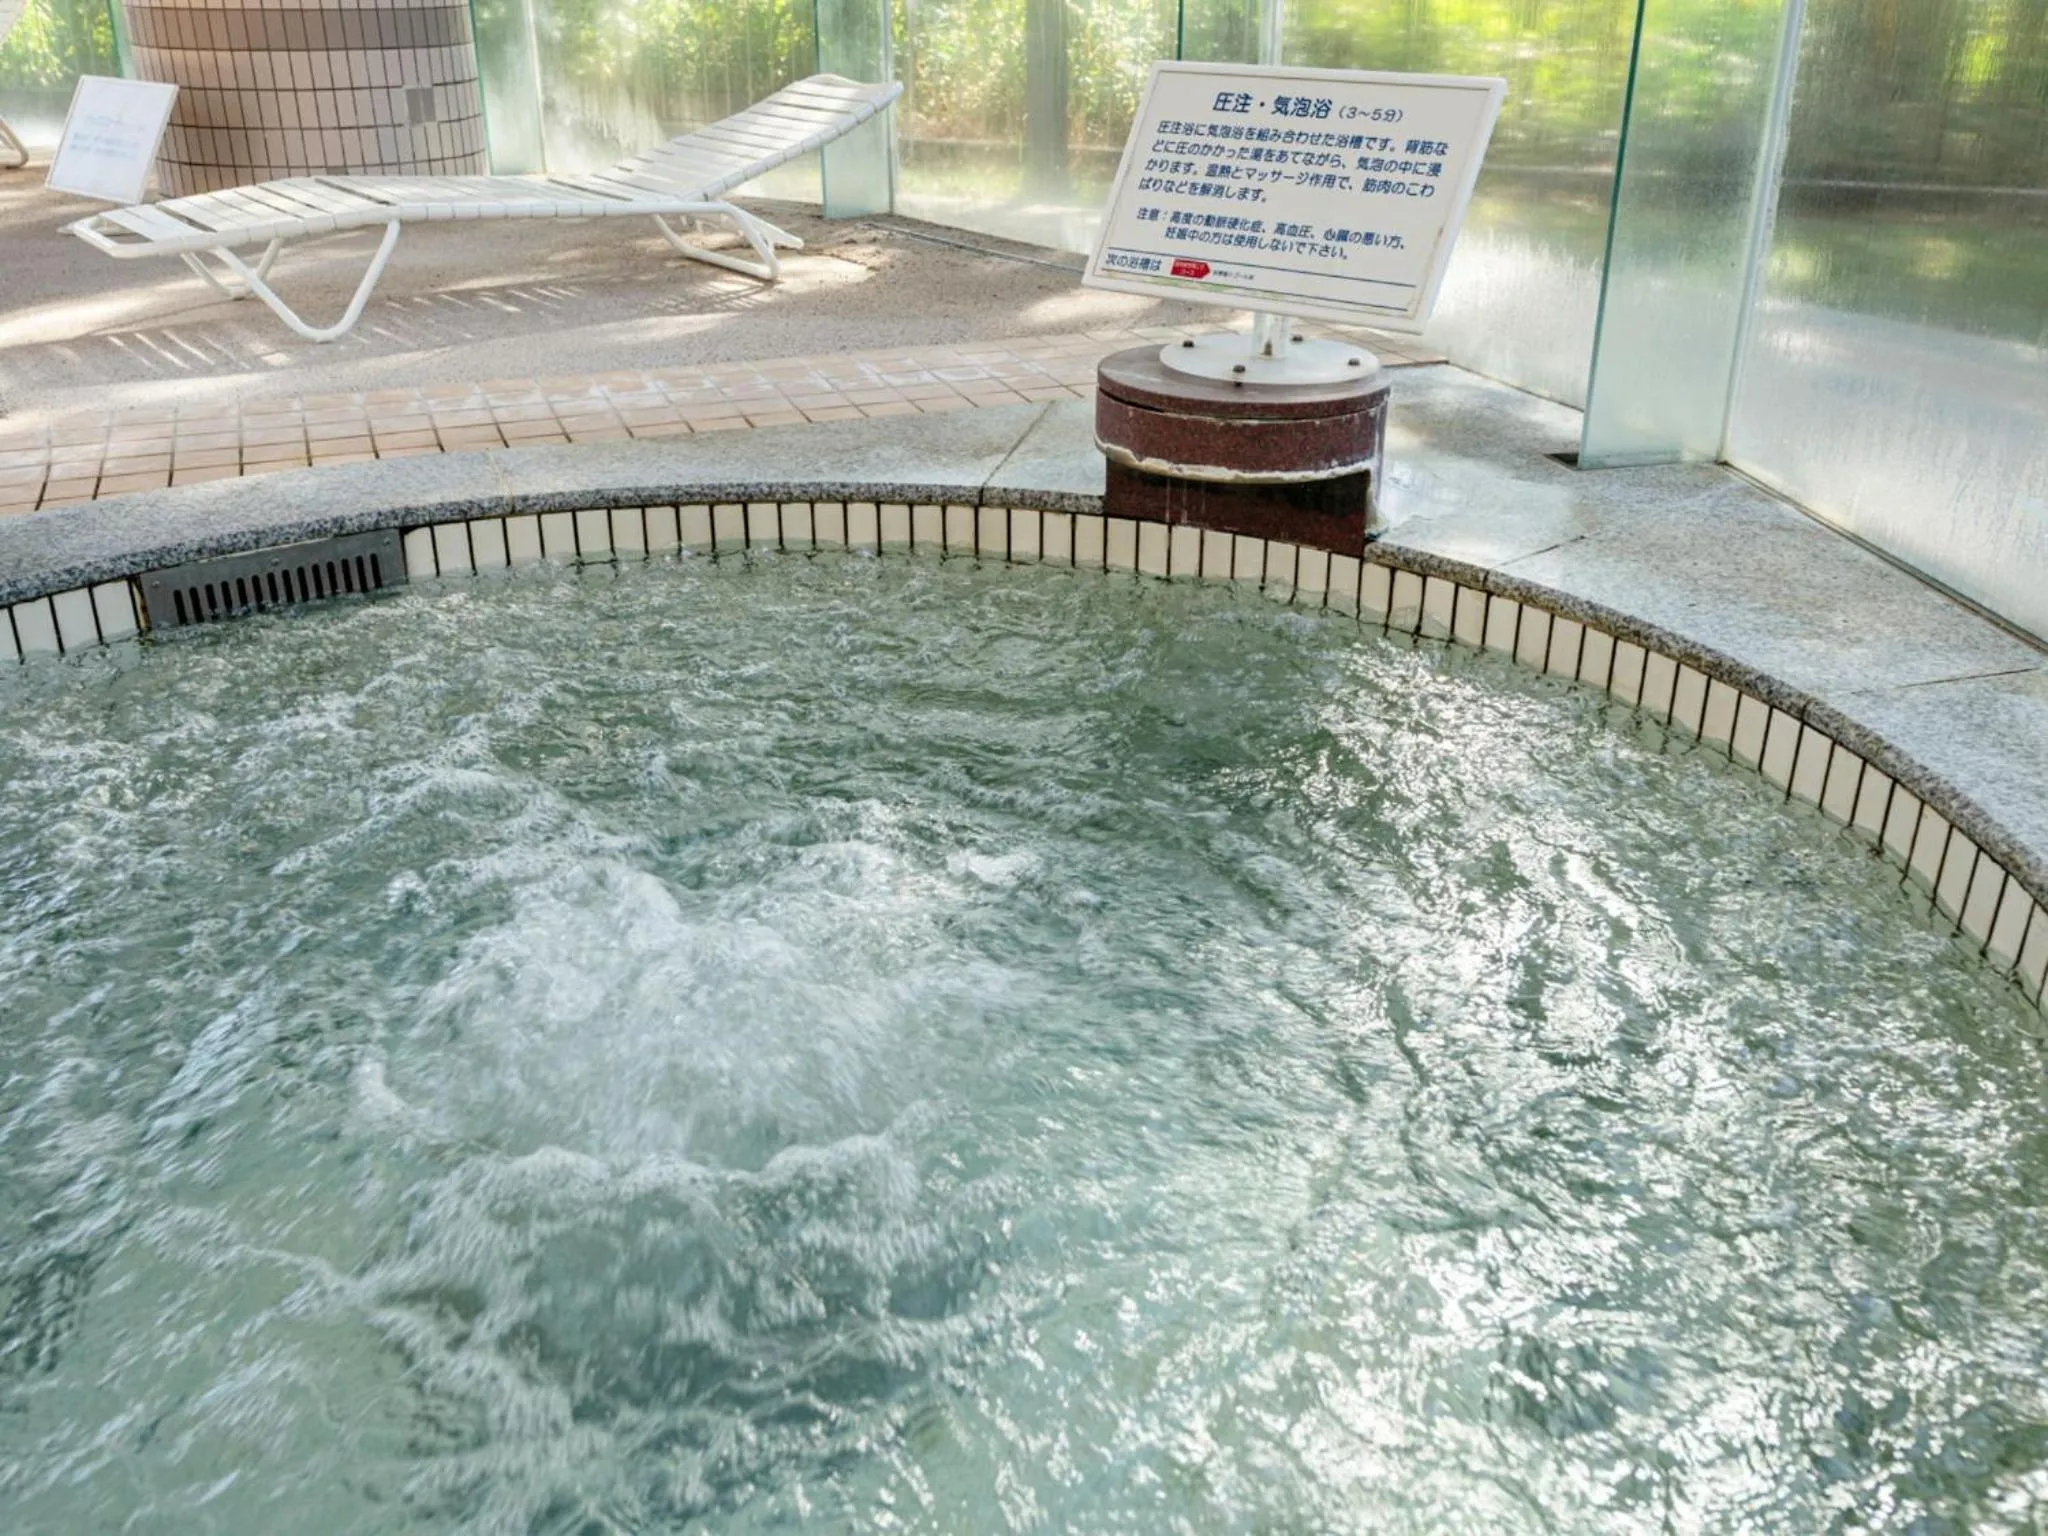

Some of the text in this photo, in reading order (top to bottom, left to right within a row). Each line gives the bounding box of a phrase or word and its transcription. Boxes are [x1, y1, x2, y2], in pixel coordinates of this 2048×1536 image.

[1212, 92, 1332, 119] 圧注・気泡浴
[1106, 253, 1162, 272] 次の浴槽は
